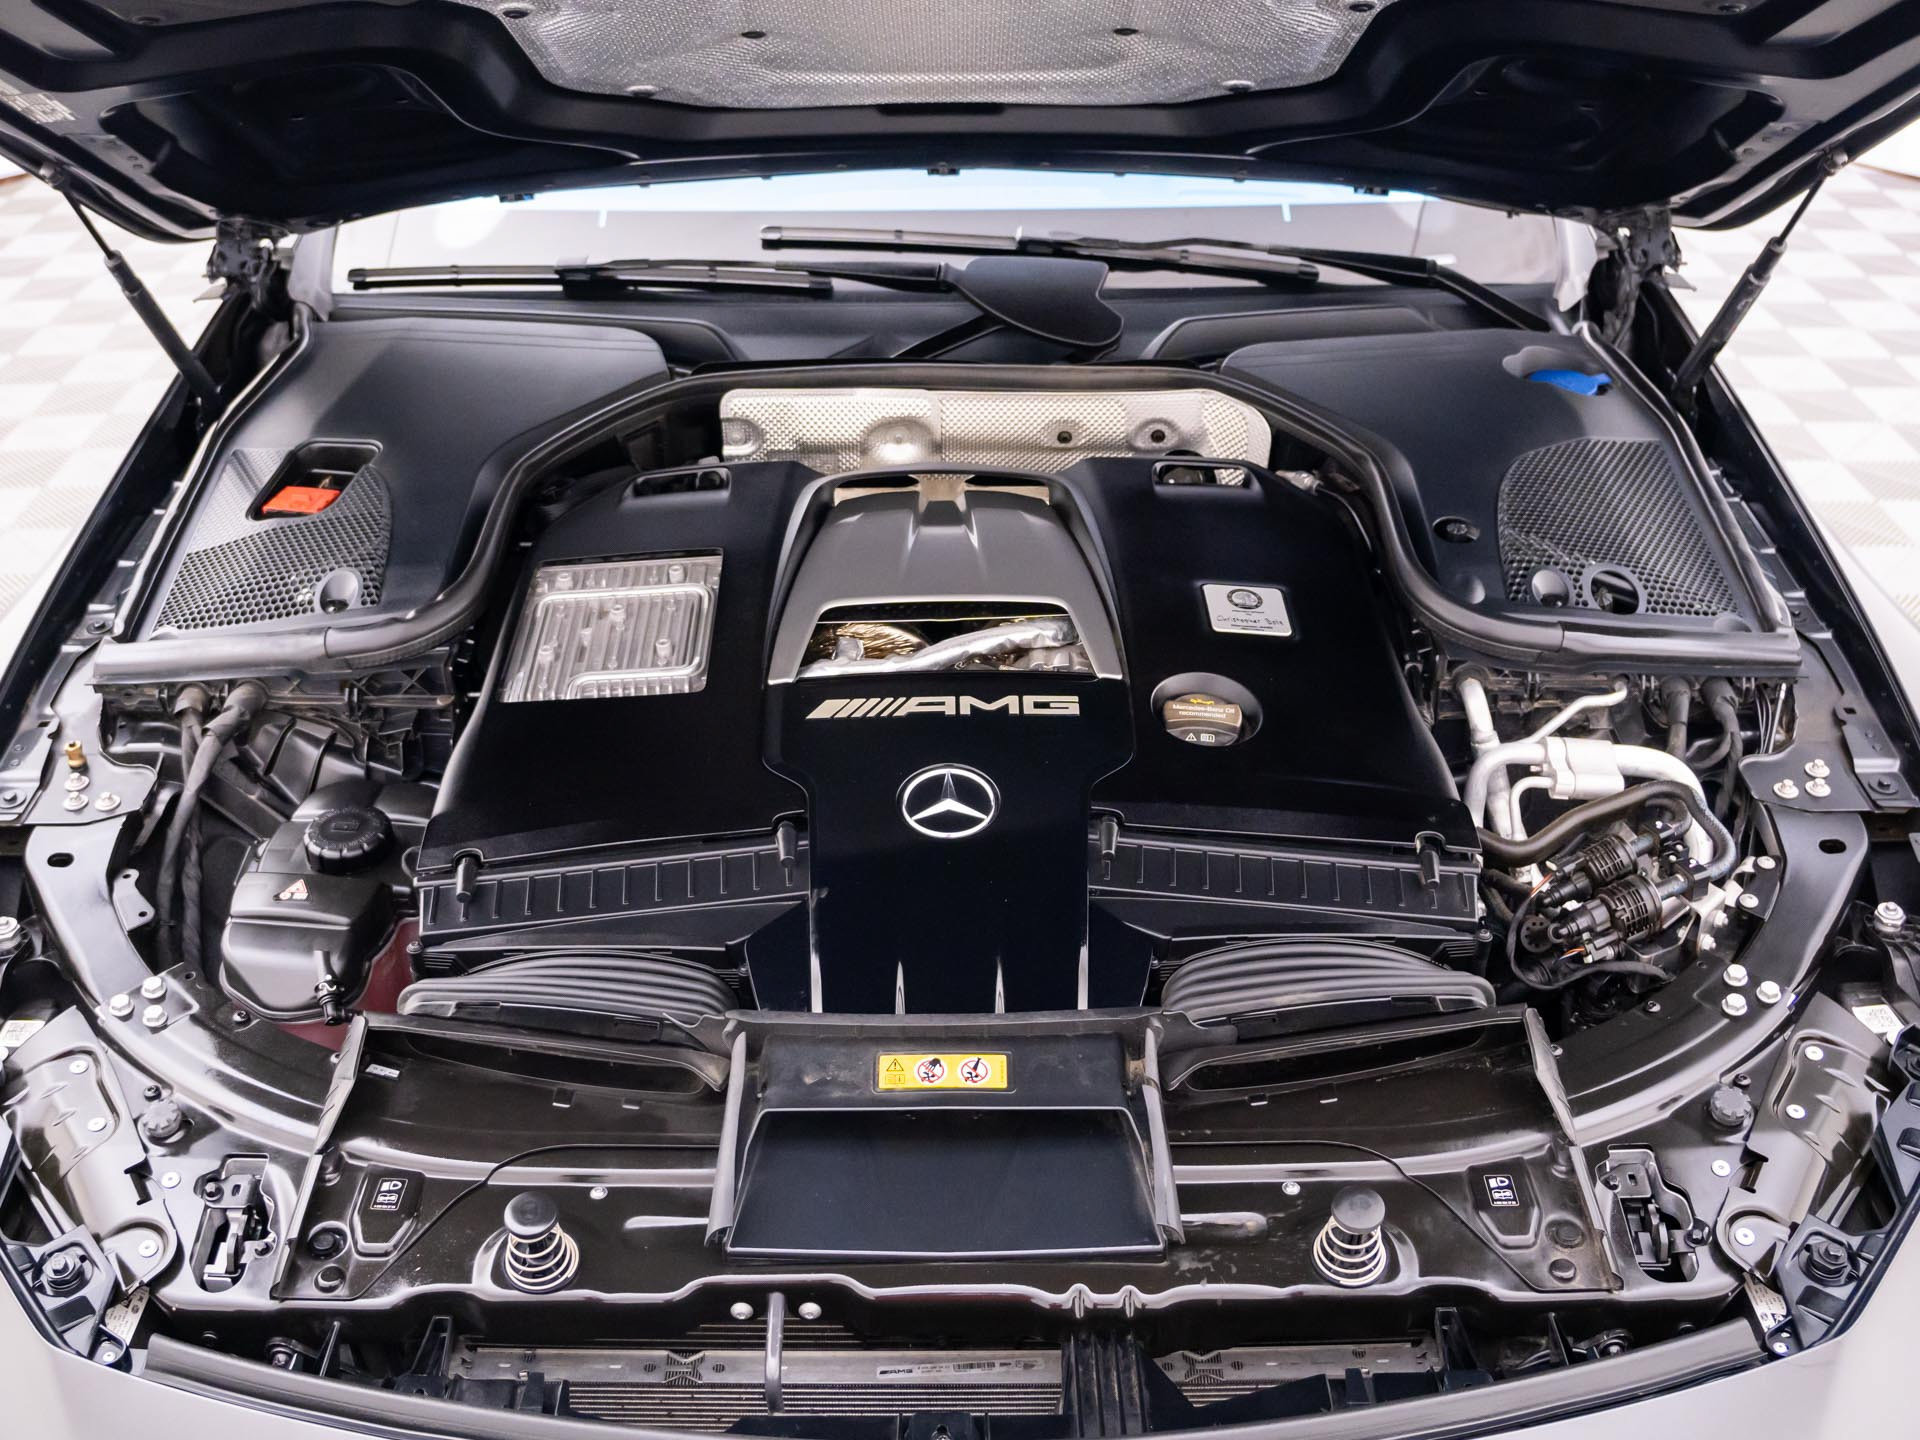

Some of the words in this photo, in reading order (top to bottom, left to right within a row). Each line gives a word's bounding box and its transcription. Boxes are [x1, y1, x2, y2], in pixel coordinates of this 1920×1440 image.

[892, 696, 1080, 716] AMG
[1172, 704, 1224, 713] Mercedes-Benz
[1225, 706, 1235, 714] Oil
[1179, 711, 1226, 719] recommended
